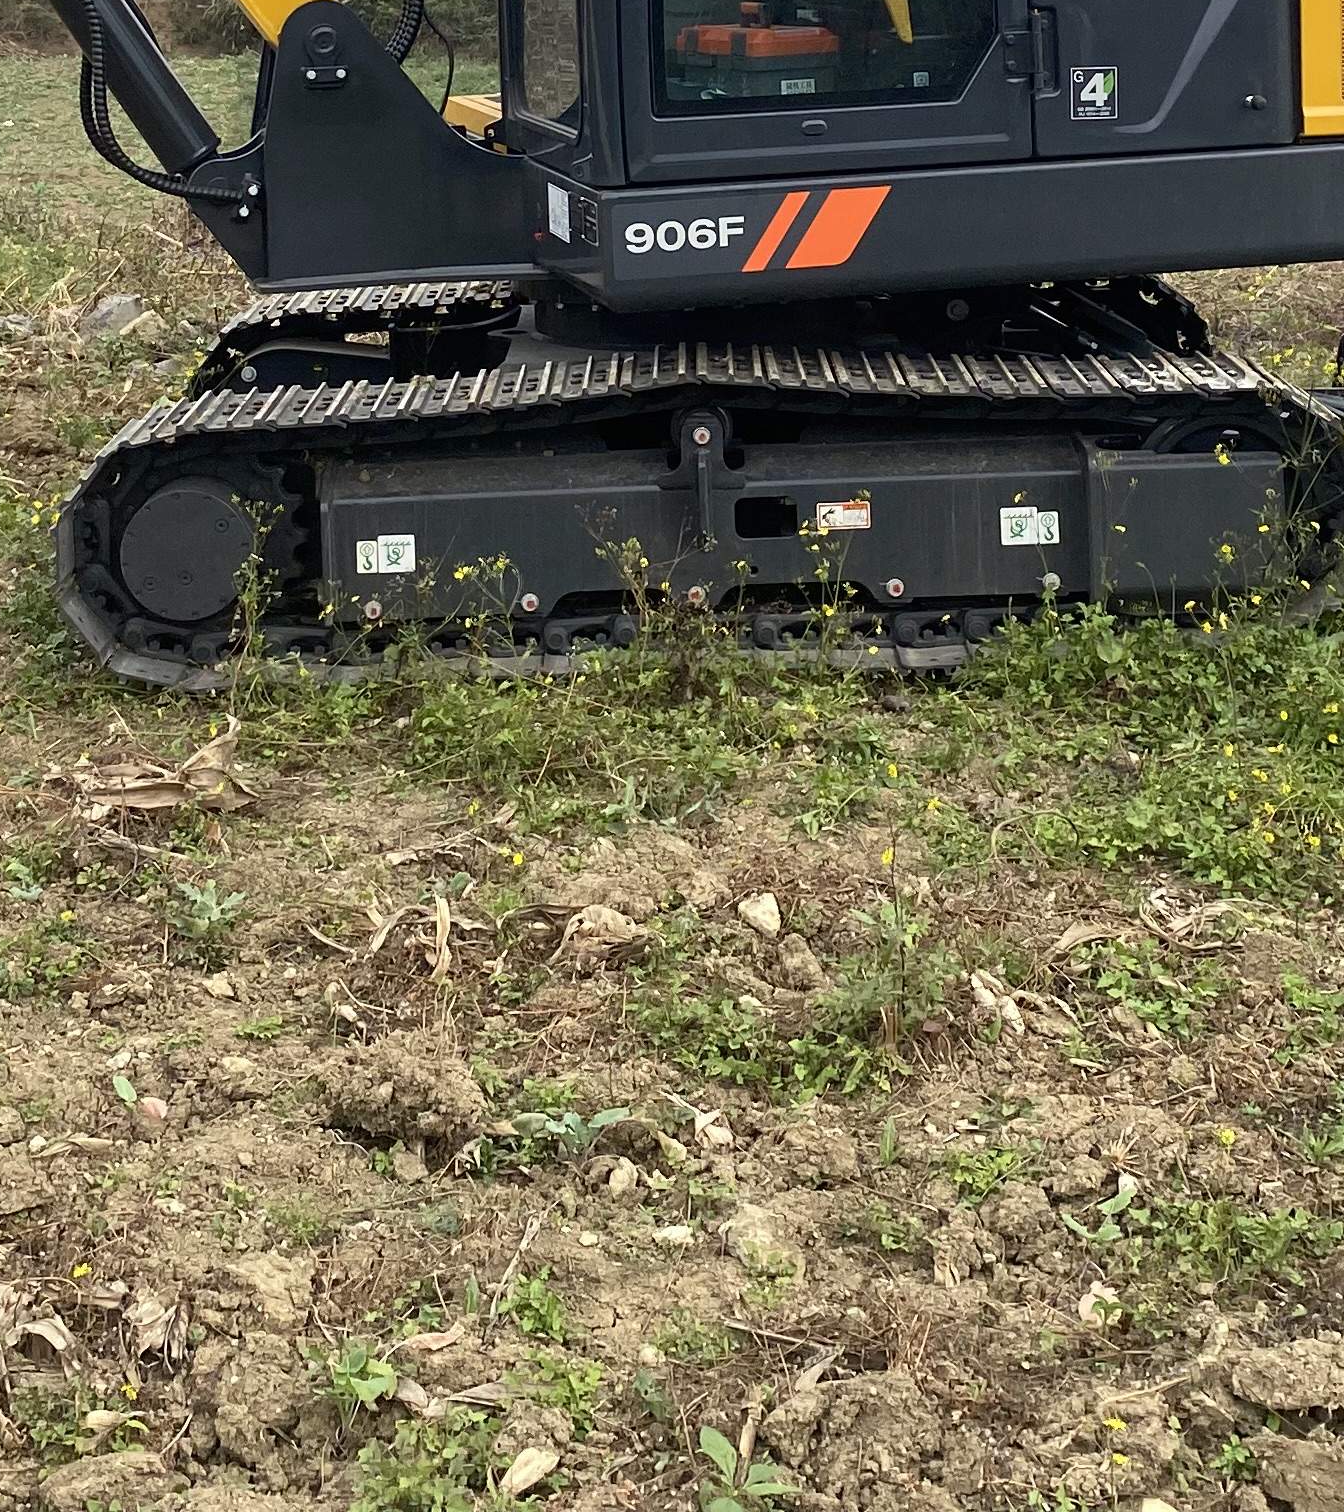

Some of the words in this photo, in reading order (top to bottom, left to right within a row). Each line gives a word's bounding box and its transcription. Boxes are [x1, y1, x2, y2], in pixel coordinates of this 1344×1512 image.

[1073, 70, 1084, 83] G
[1080, 72, 1108, 107] 4
[624, 216, 745, 254] 906F
